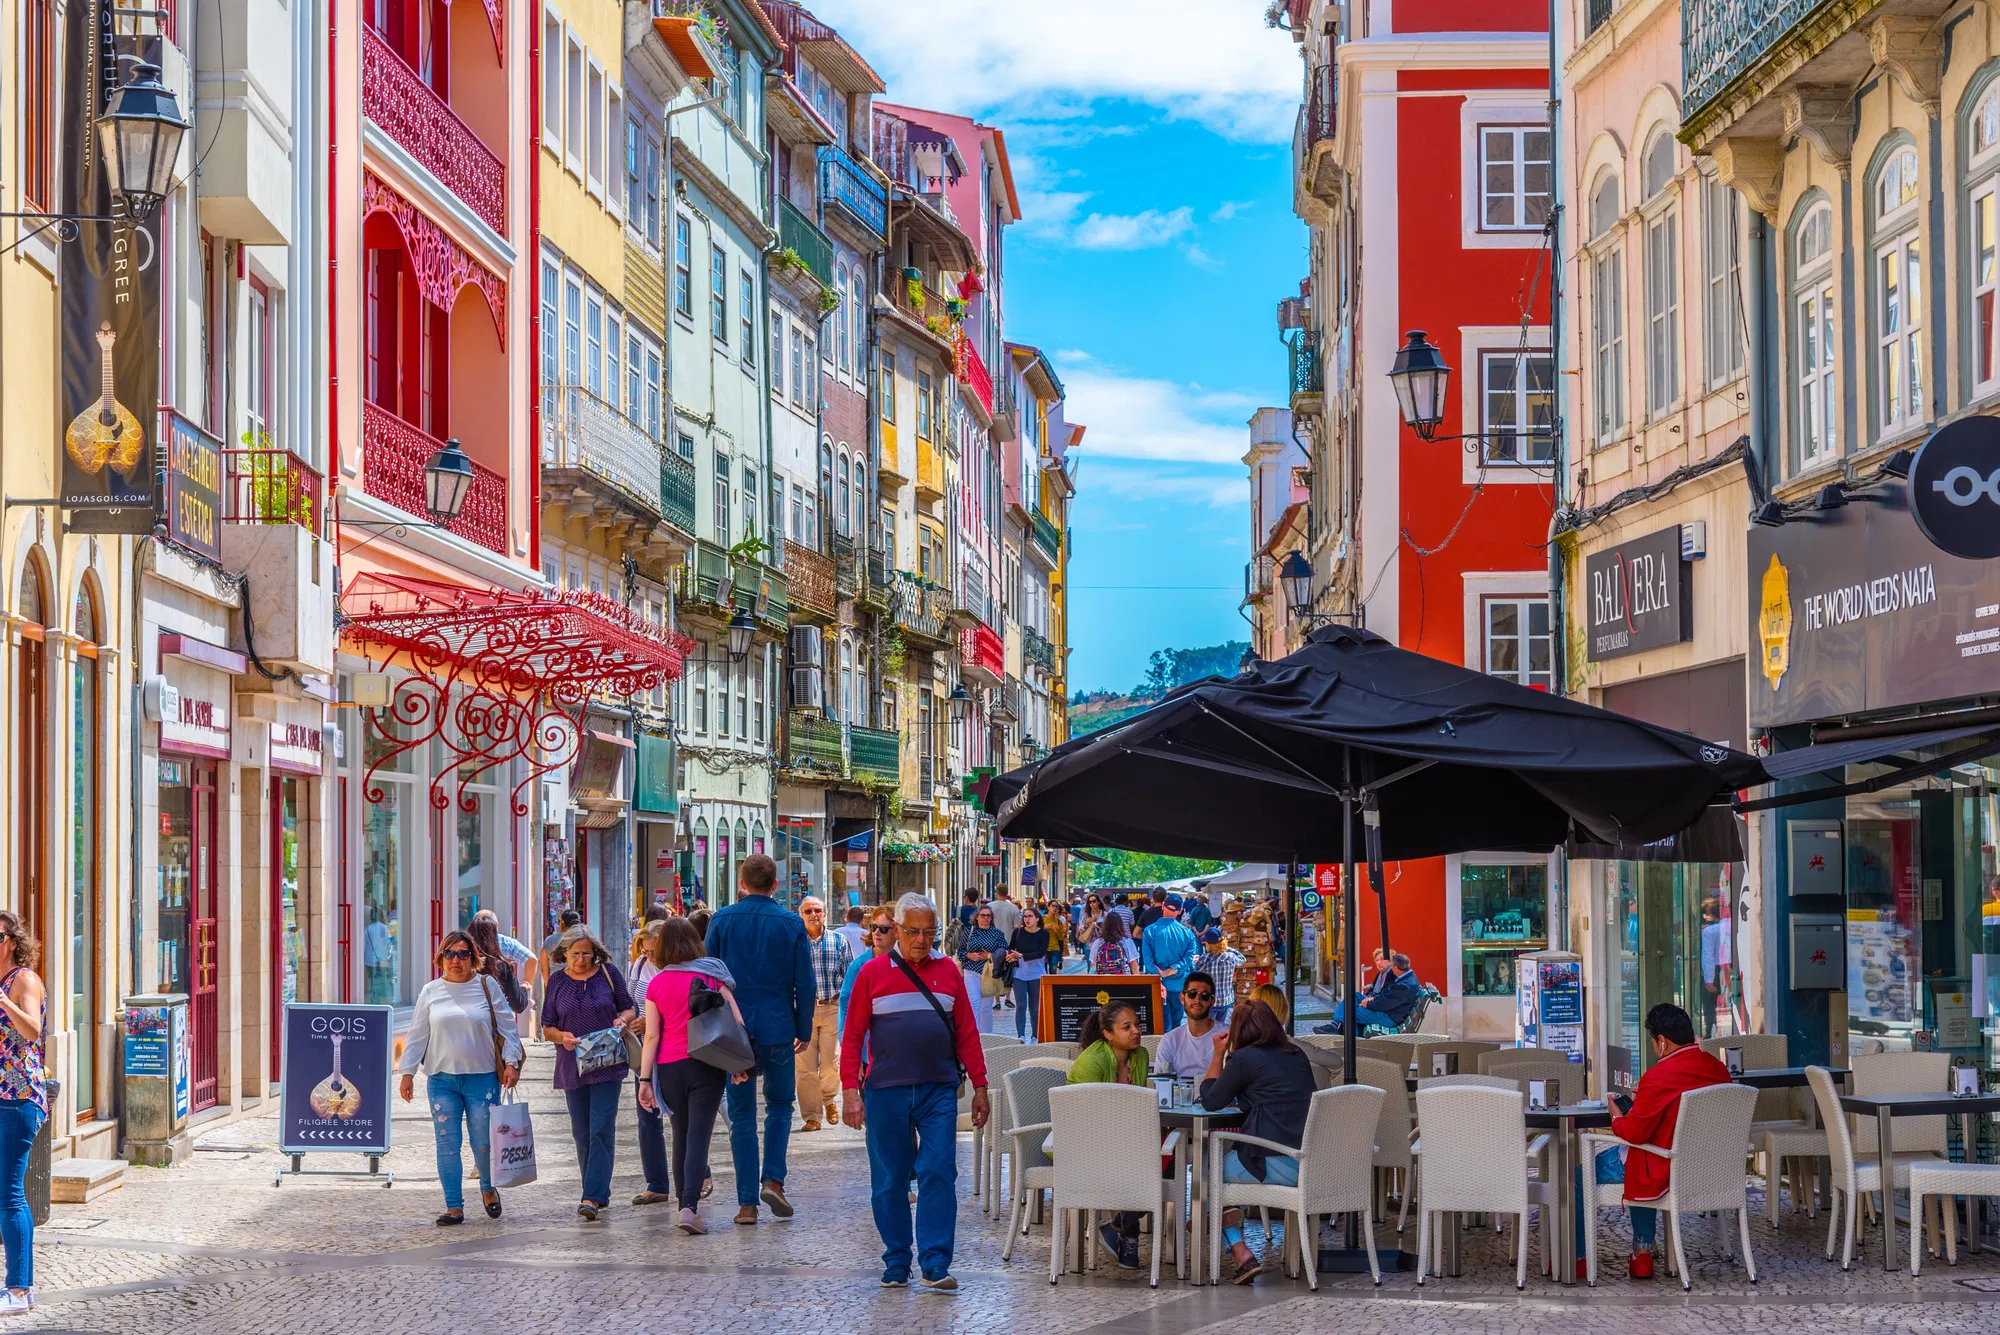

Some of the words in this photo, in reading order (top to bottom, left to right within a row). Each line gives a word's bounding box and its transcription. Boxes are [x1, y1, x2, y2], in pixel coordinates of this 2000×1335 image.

[112, 203, 130, 304] ILIGREE
[170, 426, 220, 495] CABELEIREIR
[66, 494, 146, 504] LOJASGOIS.COM
[180, 490, 213, 548] ESTÉTICA
[1594, 550, 1670, 634] BALVERA
[1804, 594, 1822, 632] THE
[1824, 584, 1864, 628] WORLD
[1864, 574, 1900, 618] NEEDS
[1902, 564, 1936, 608] NATA
[1596, 630, 1628, 654] PERFUMARIAS
